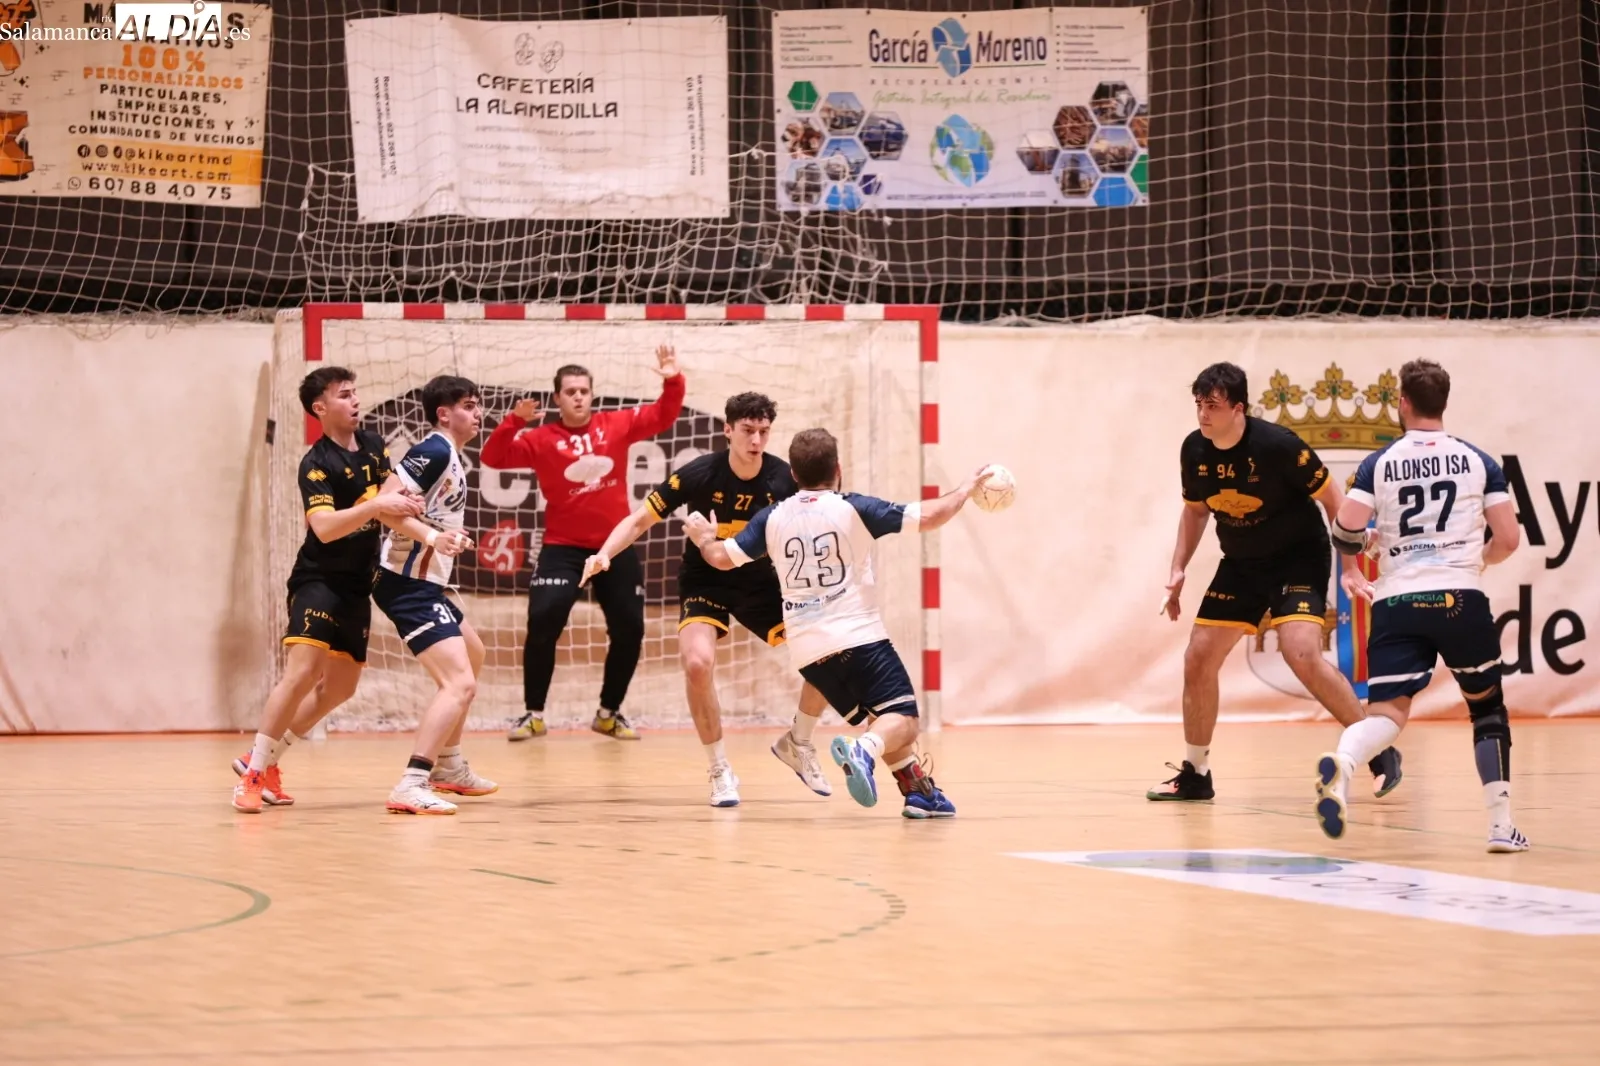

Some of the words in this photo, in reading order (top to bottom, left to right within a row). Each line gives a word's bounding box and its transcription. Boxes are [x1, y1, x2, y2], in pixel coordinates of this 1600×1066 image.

[868, 28, 928, 63] García
[976, 30, 1047, 63] Moreno
[122, 44, 206, 72] 100%
[83, 66, 244, 90] PERSONALIZADOS
[477, 72, 594, 94] CAFETERÍA
[99, 83, 227, 105] PARTICULARES,
[117, 98, 208, 117] EMPRESAS,
[456, 97, 479, 113] LA
[487, 98, 618, 119] ALAMEDILLA
[90, 110, 215, 130] INSTITUCIONES
[225, 120, 234, 131] Y
[68, 125, 161, 139] COMUNIDADES
[169, 131, 186, 142] DE
[194, 133, 255, 145] VECINOS
[124, 148, 232, 165] @kikeartmd
[167, 183, 195, 198] 40
[206, 186, 232, 200] 75
[570, 432, 593, 457] 31
[1217, 463, 1236, 479] 94
[1384, 457, 1440, 482] ALONSO
[1446, 455, 1471, 475] ISA
[734, 494, 753, 511] 27
[1399, 480, 1458, 537] 27
[1484, 455, 1600, 569] Ay
[785, 531, 846, 588] 23
[1495, 584, 1586, 676] de
